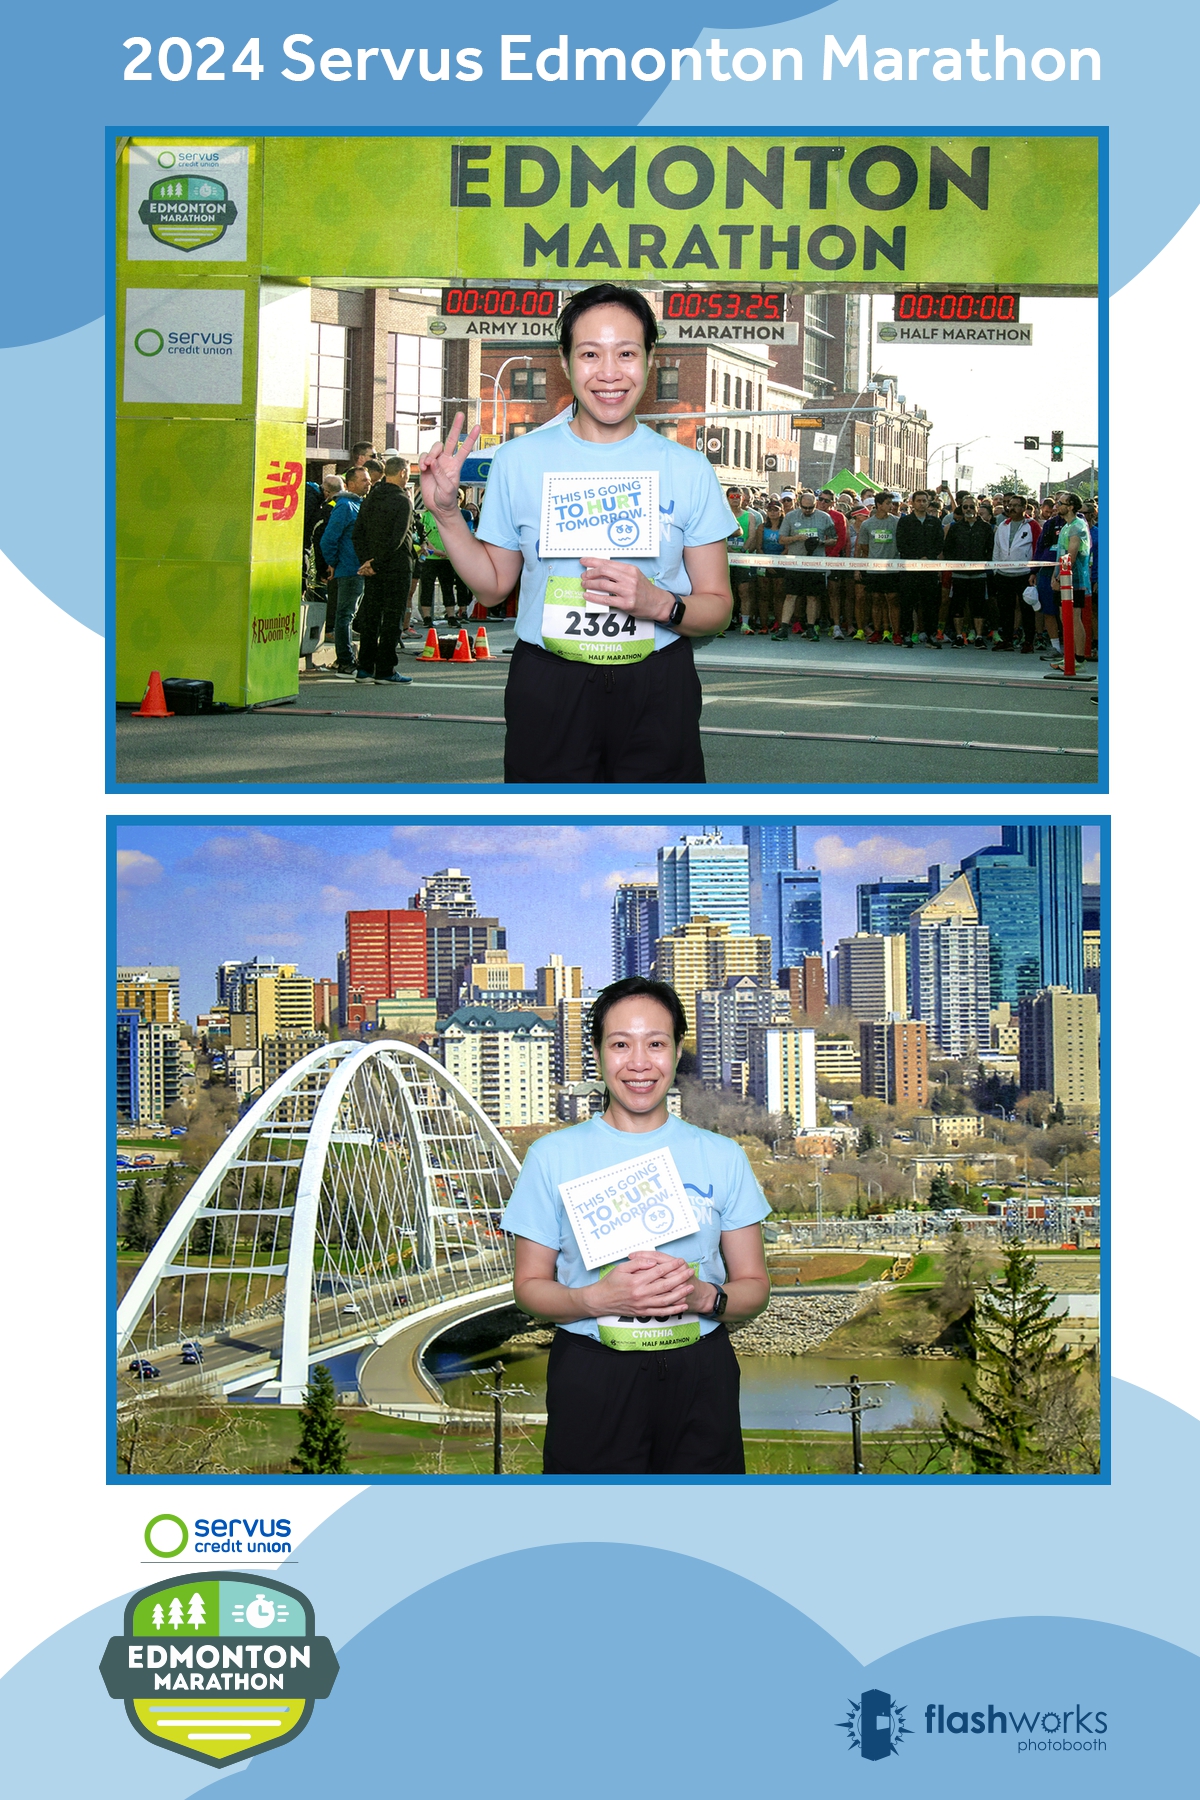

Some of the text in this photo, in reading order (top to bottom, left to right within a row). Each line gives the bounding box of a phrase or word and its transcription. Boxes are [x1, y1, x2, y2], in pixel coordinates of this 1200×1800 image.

[178, 153, 219, 161] servus
[450, 145, 990, 211] EDMONTON
[149, 203, 227, 214] EDMONTON
[160, 214, 215, 222] MARATHON
[523, 223, 906, 271] MARATHON
[466, 321, 554, 336] ARMY 10K
[679, 325, 785, 340] MARATHON
[900, 328, 939, 340] HALF
[943, 328, 1031, 341] MARATHON
[168, 332, 233, 345] servus
[168, 345, 232, 355] credit union
[552, 480, 641, 505] THIS IS GOING
[555, 492, 641, 520] TO HURT
[556, 508, 646, 532] TOMORROW.
[257, 613, 290, 643] Running
[564, 611, 637, 637] 2364
[579, 643, 623, 652] CYNTHIA
[575, 1163, 657, 1214] THIS IS GOING
[583, 1173, 662, 1227] TO HURT
[590, 1188, 674, 1240] TOMORROW.
[632, 1329, 673, 1338] CYNTHIA
[659, 1337, 690, 1346] MARATHON
